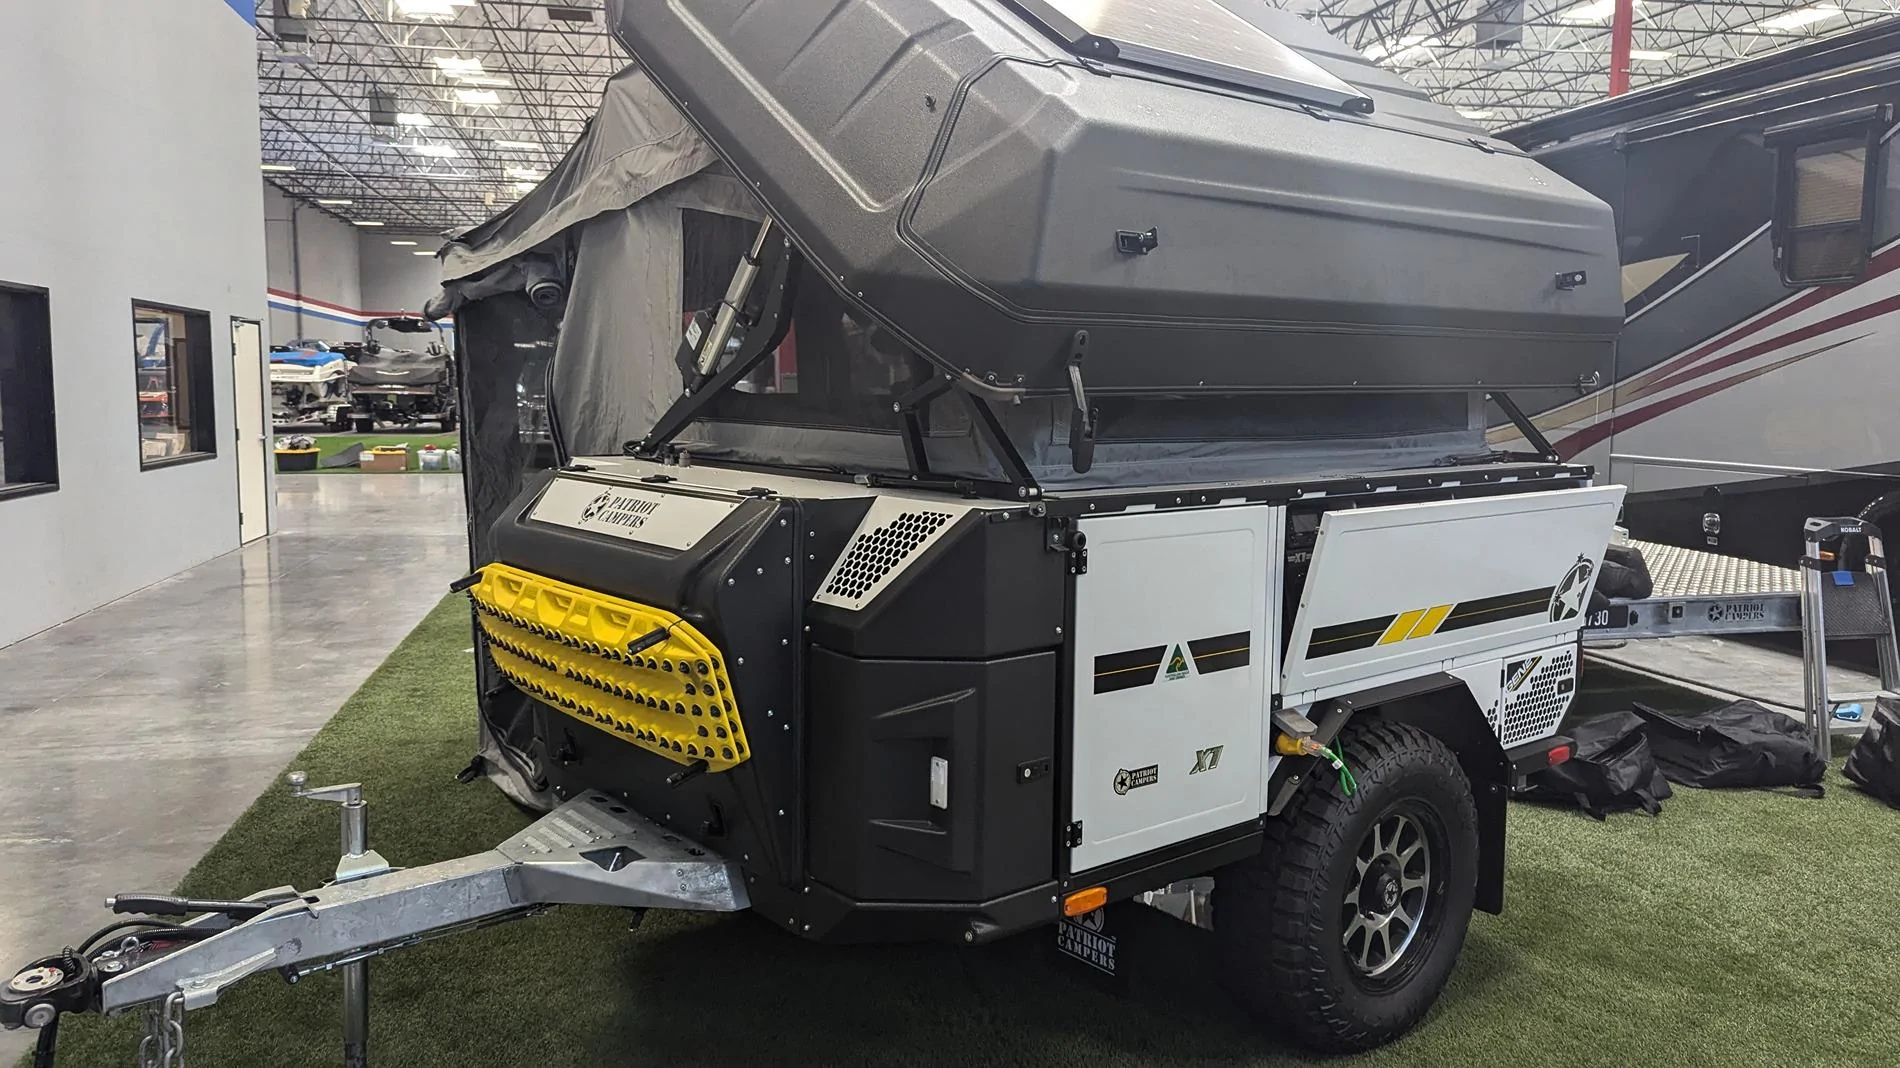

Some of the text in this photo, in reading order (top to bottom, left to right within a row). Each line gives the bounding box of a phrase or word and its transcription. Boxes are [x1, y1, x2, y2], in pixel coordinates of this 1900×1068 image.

[608, 496, 660, 515] PATRIOT
[597, 510, 648, 529] CAMPERS
[1725, 611, 1765, 620] CAMPERS
[1726, 603, 1764, 612] PATRIOT
[1130, 775, 1157, 787] CAMPERS
[1131, 767, 1157, 780] PATRIOT
[1059, 921, 1115, 957] PATRIOT
[1058, 935, 1115, 970] CAMPERS
